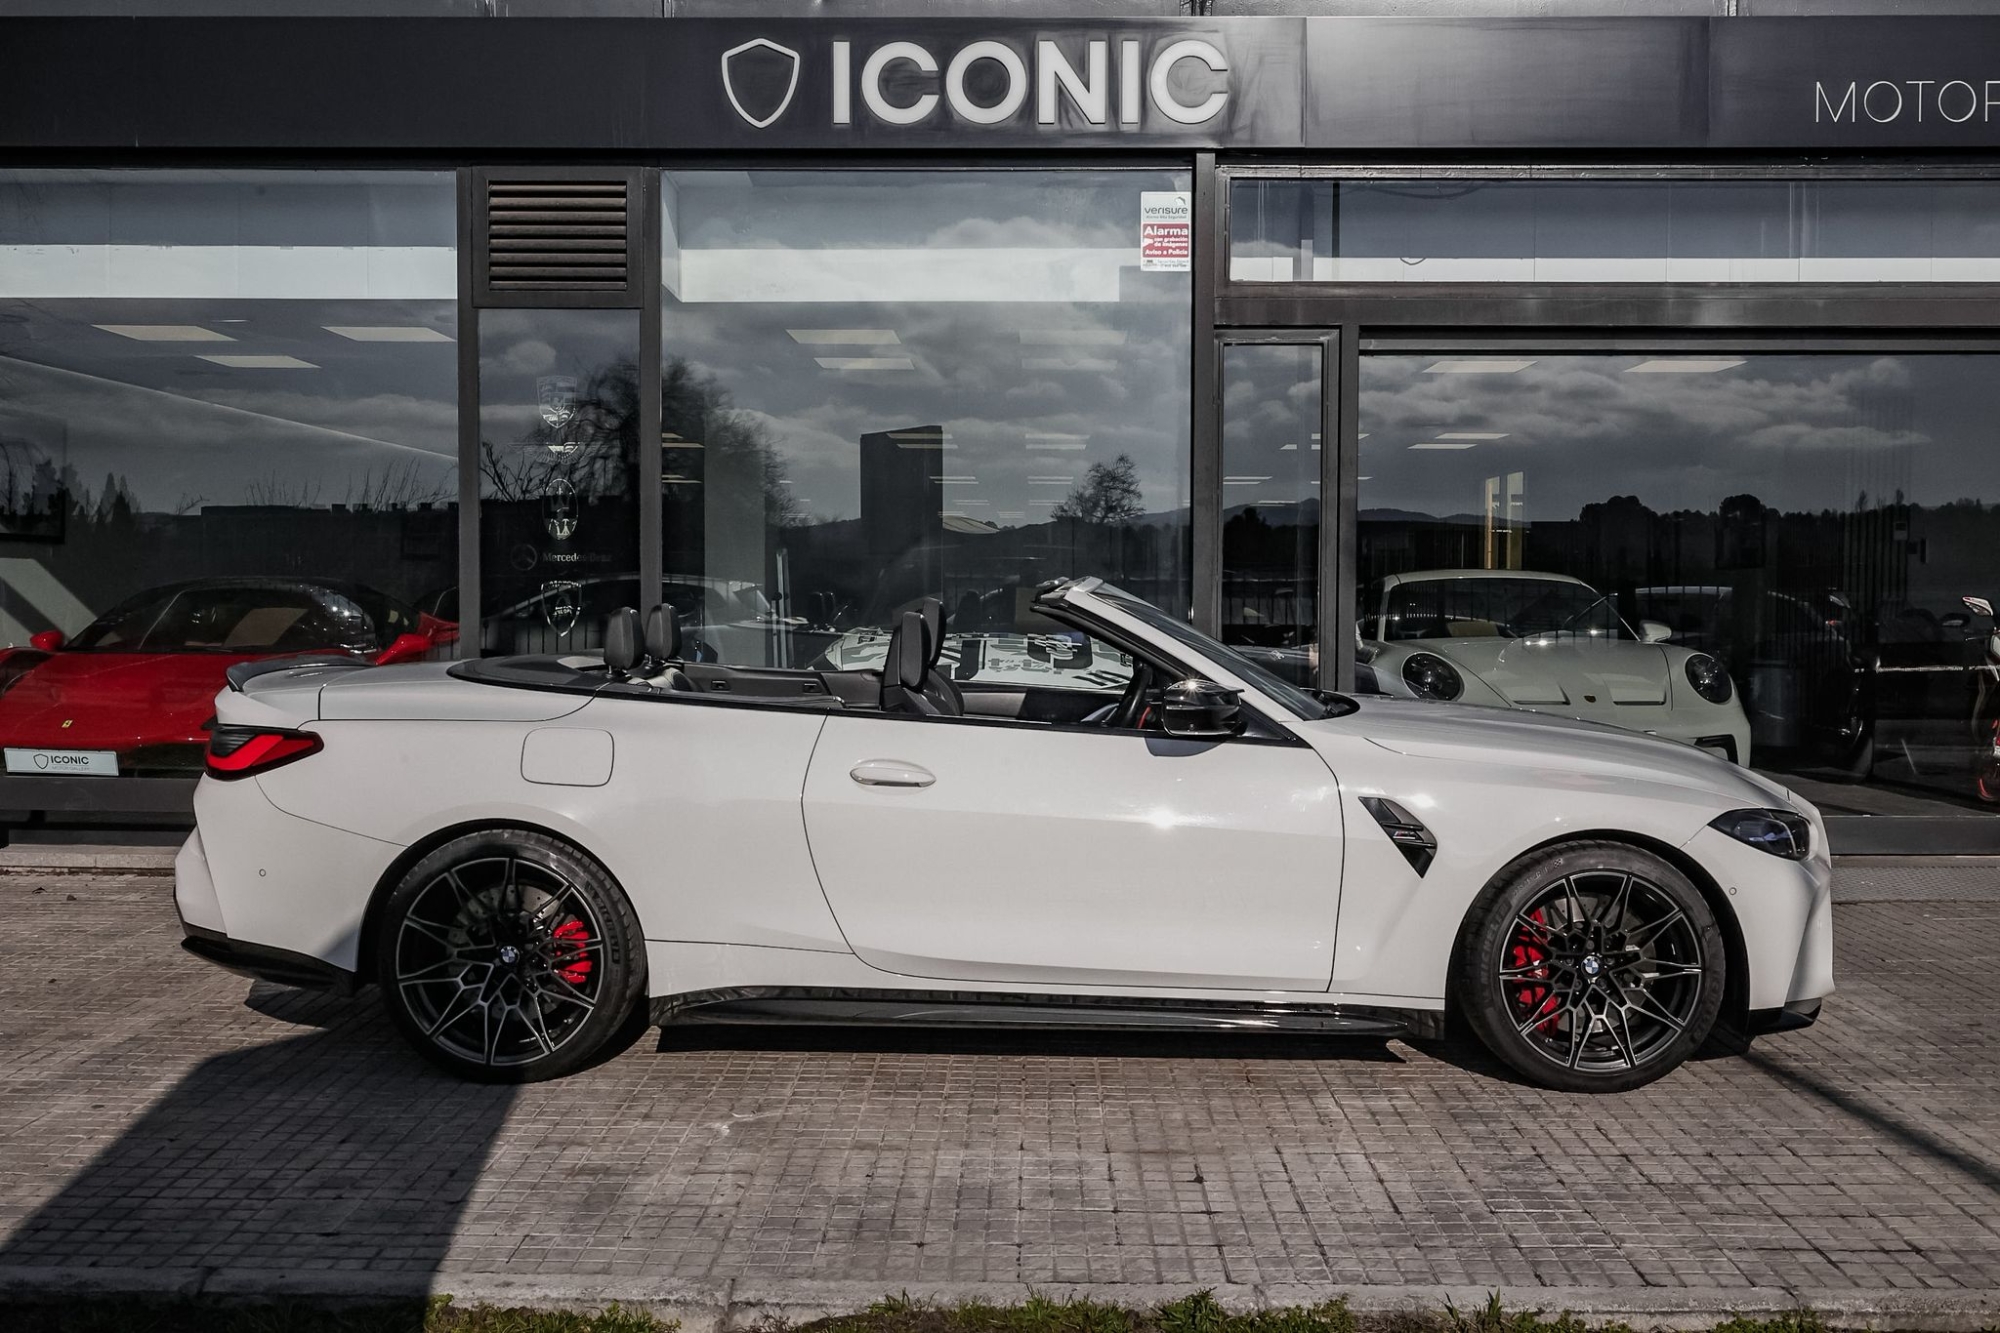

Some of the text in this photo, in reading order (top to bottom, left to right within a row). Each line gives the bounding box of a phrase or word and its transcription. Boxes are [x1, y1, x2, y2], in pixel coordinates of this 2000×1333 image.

[833, 39, 1228, 125] ICONIC
[1144, 206, 1188, 215] verisure
[1144, 225, 1188, 235] Alarma
[50, 755, 89, 765] ICONIC
